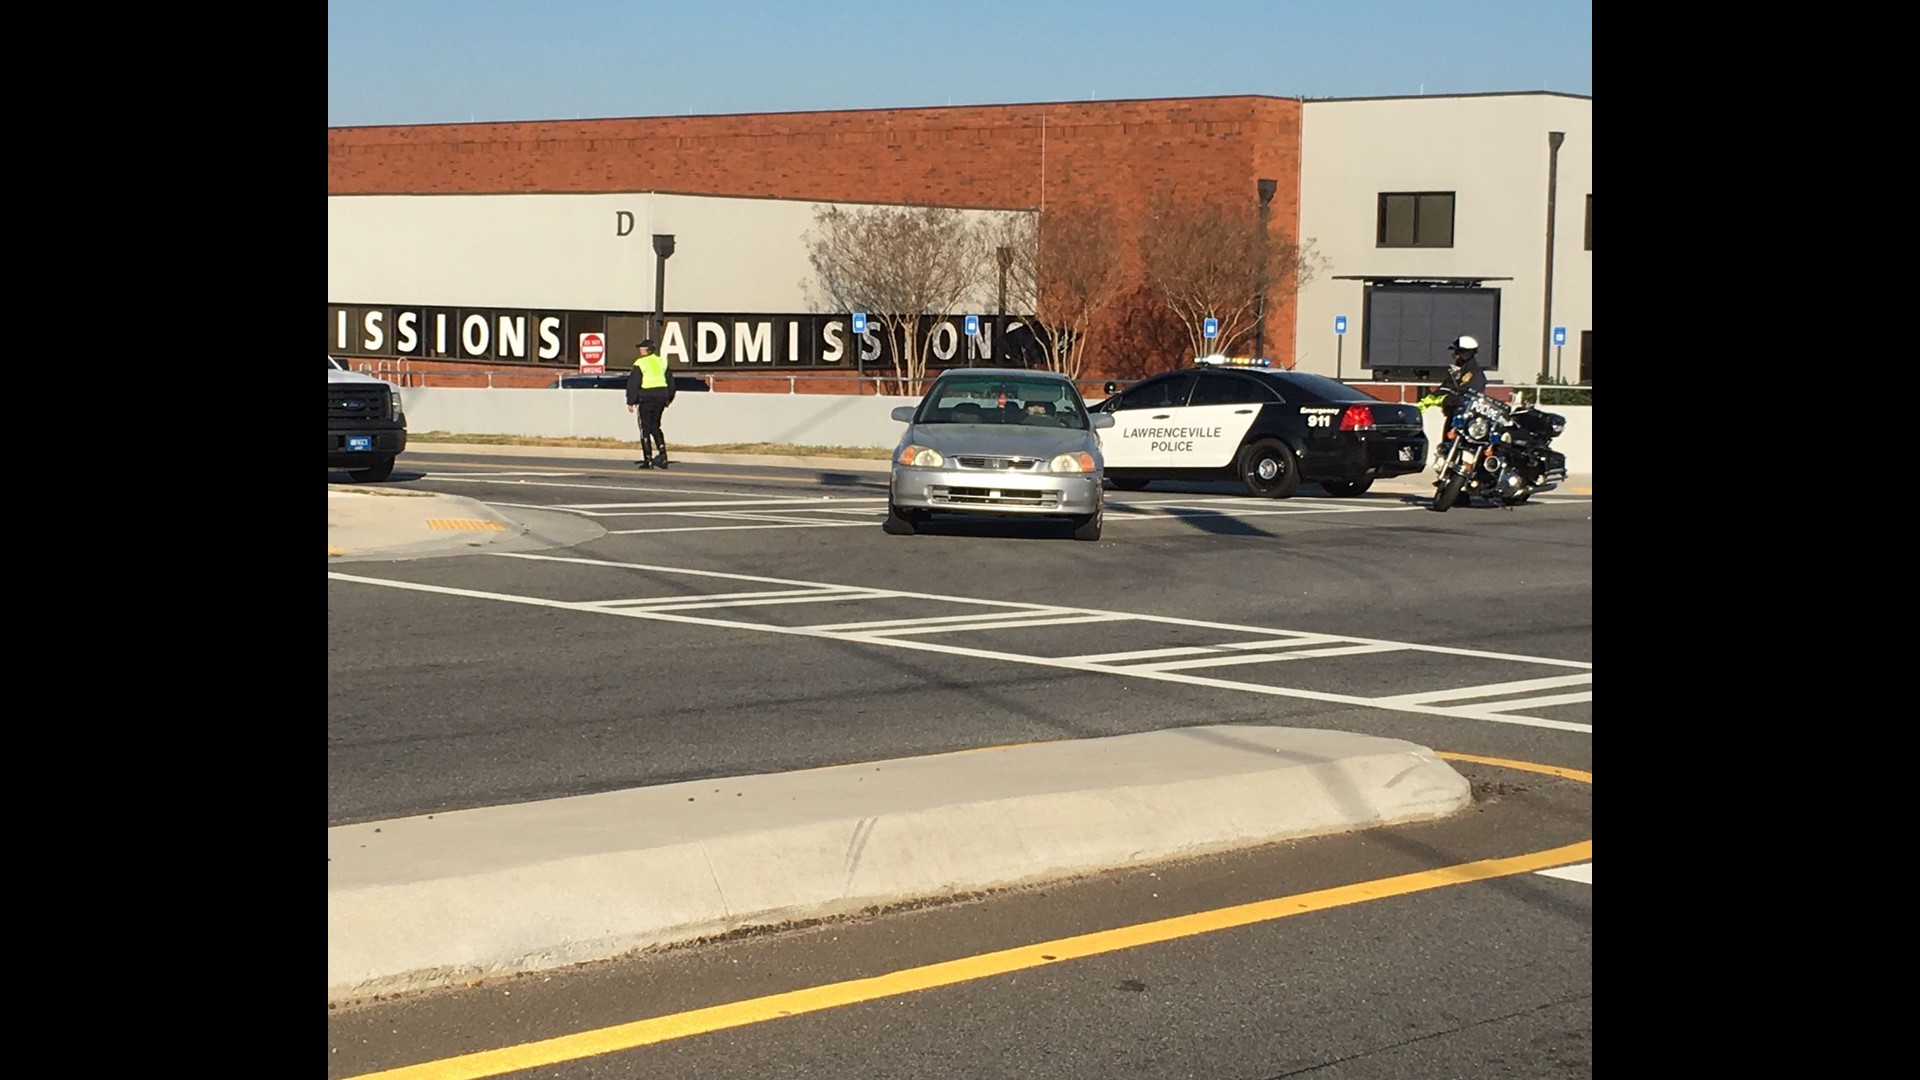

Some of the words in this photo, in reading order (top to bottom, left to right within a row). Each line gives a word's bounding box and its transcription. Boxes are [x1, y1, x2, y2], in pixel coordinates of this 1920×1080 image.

[616, 211, 635, 237] D
[337, 310, 561, 360] ISSIONS
[660, 321, 1024, 364] ADMISSON
[1299, 406, 1340, 416] Emergency
[1307, 415, 1331, 428] 911
[1123, 427, 1222, 438] LAWRENCEVILLE
[1151, 441, 1194, 452] POLICE
